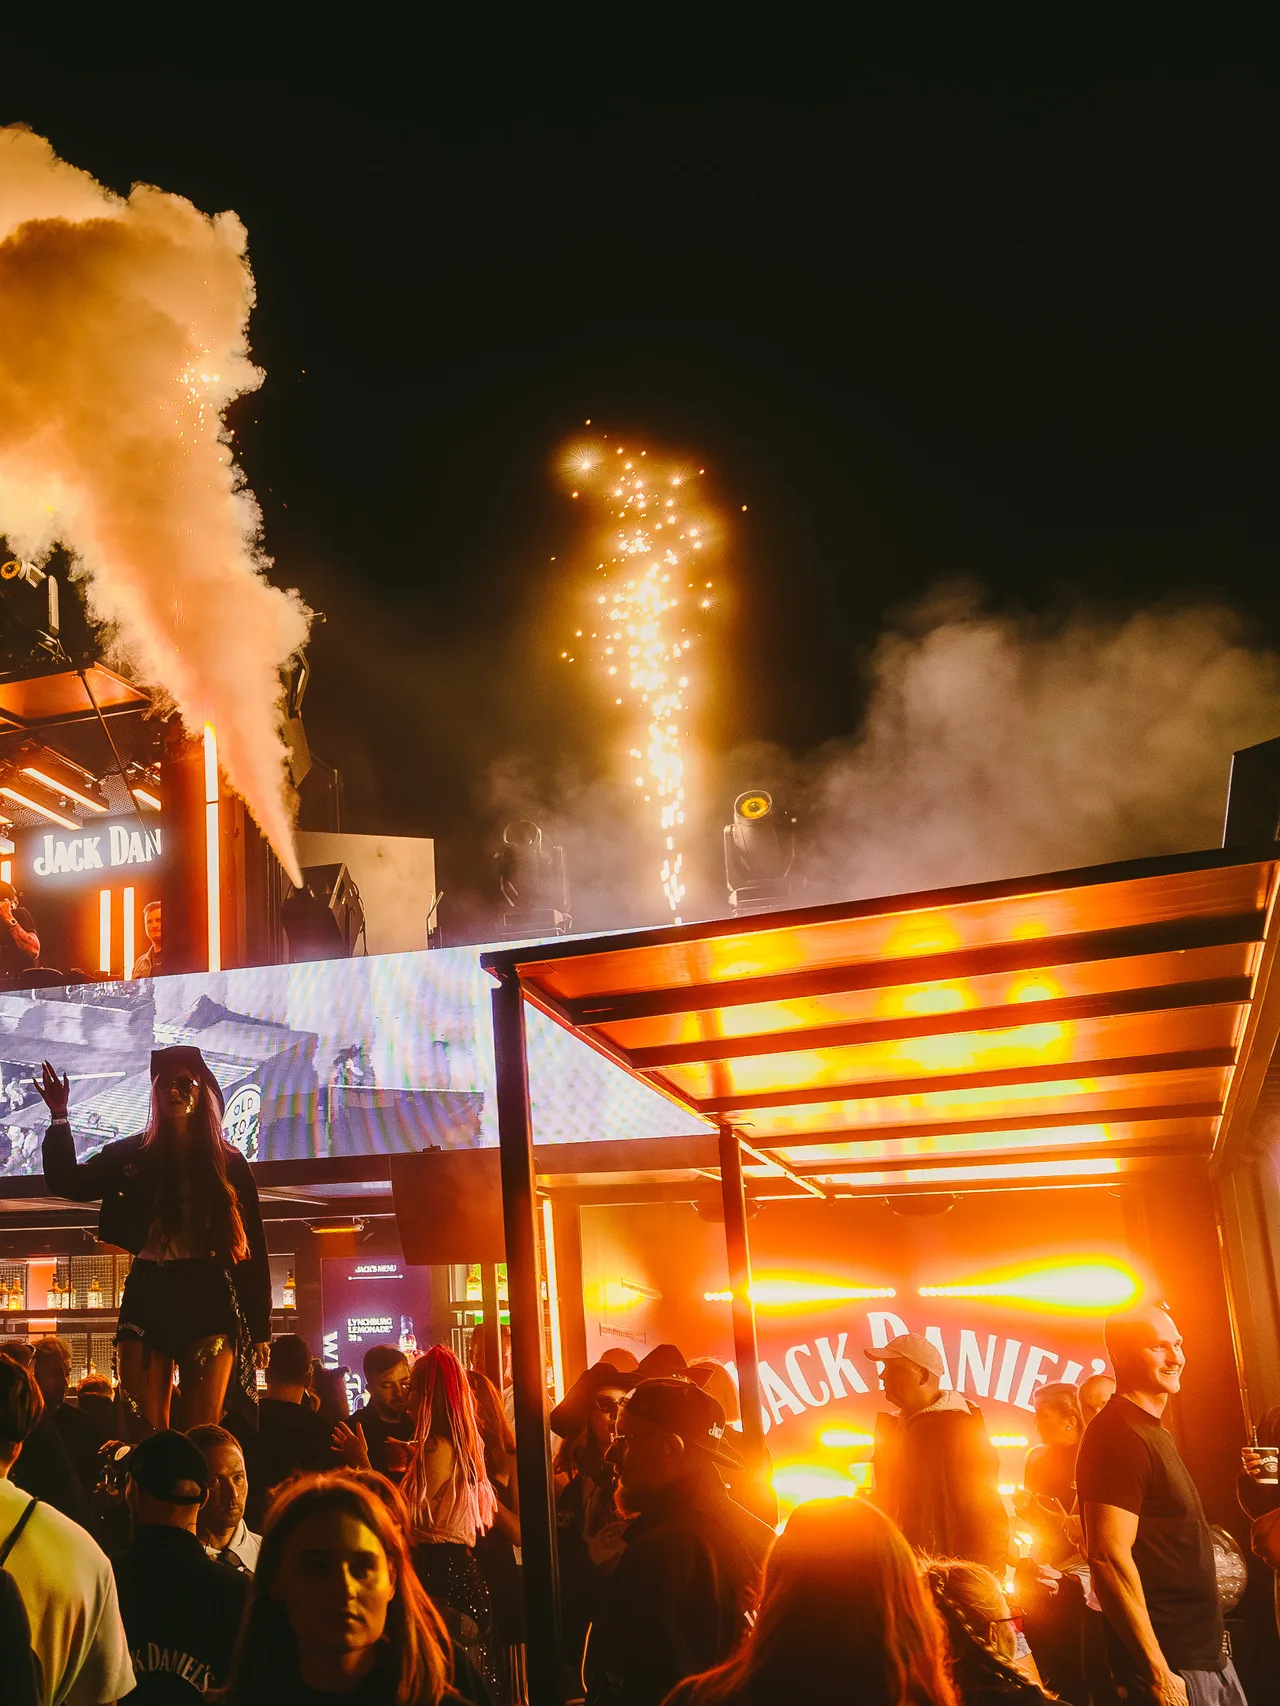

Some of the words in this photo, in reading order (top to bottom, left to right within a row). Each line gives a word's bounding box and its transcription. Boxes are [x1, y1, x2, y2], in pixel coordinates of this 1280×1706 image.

[33, 834, 104, 876] JACK
[378, 1264, 397, 1272] MENU
[347, 1317, 393, 1326] LYNCHBURG
[722, 1332, 869, 1436] ACK
